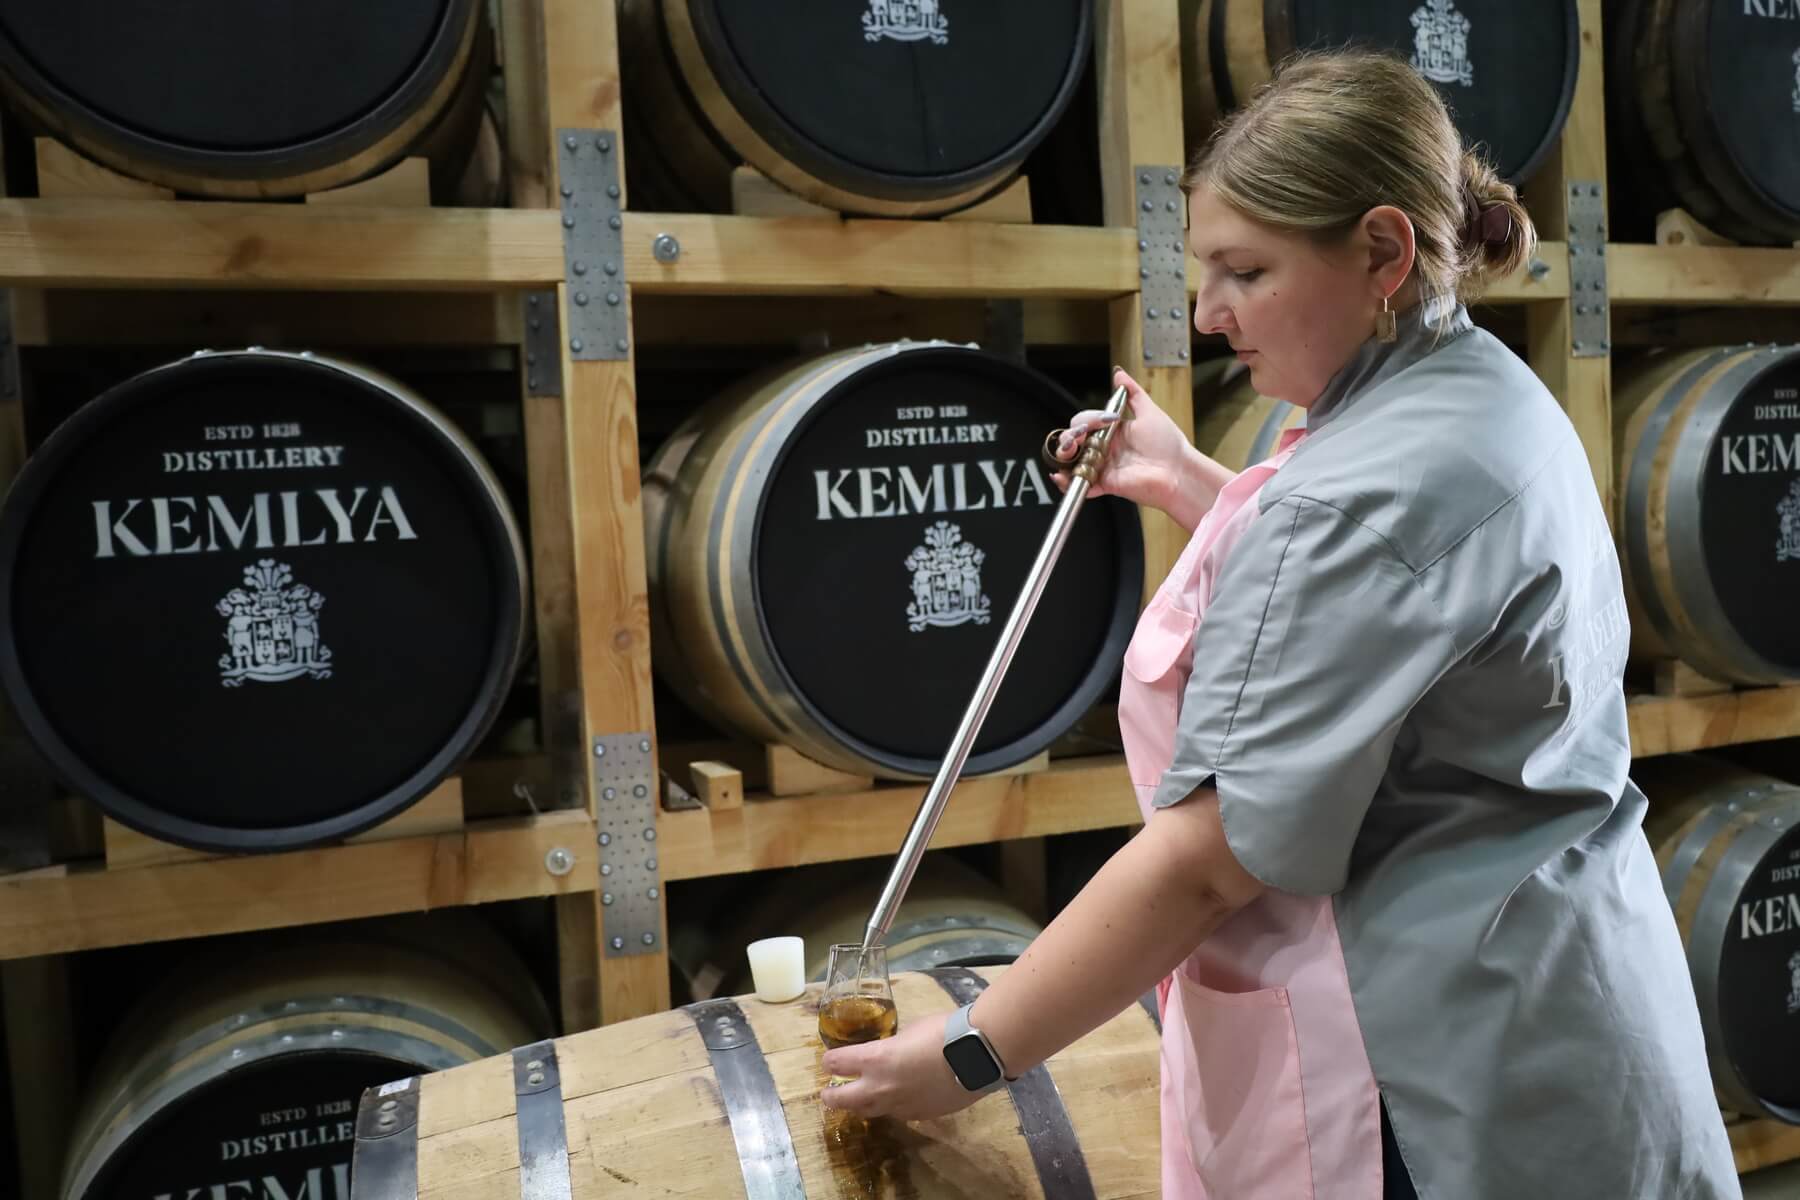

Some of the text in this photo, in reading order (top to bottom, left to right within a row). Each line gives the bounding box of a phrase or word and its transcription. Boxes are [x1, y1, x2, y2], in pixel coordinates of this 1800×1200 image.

[897, 406, 934, 420] ESTD
[204, 423, 301, 440] ESTD 1828
[865, 424, 999, 449] DISTILLERY
[163, 446, 343, 472] DISTILLERY
[814, 458, 1053, 521] KEMLYA
[92, 486, 418, 558] KEMLYA
[260, 1100, 352, 1126] ESTD 1828
